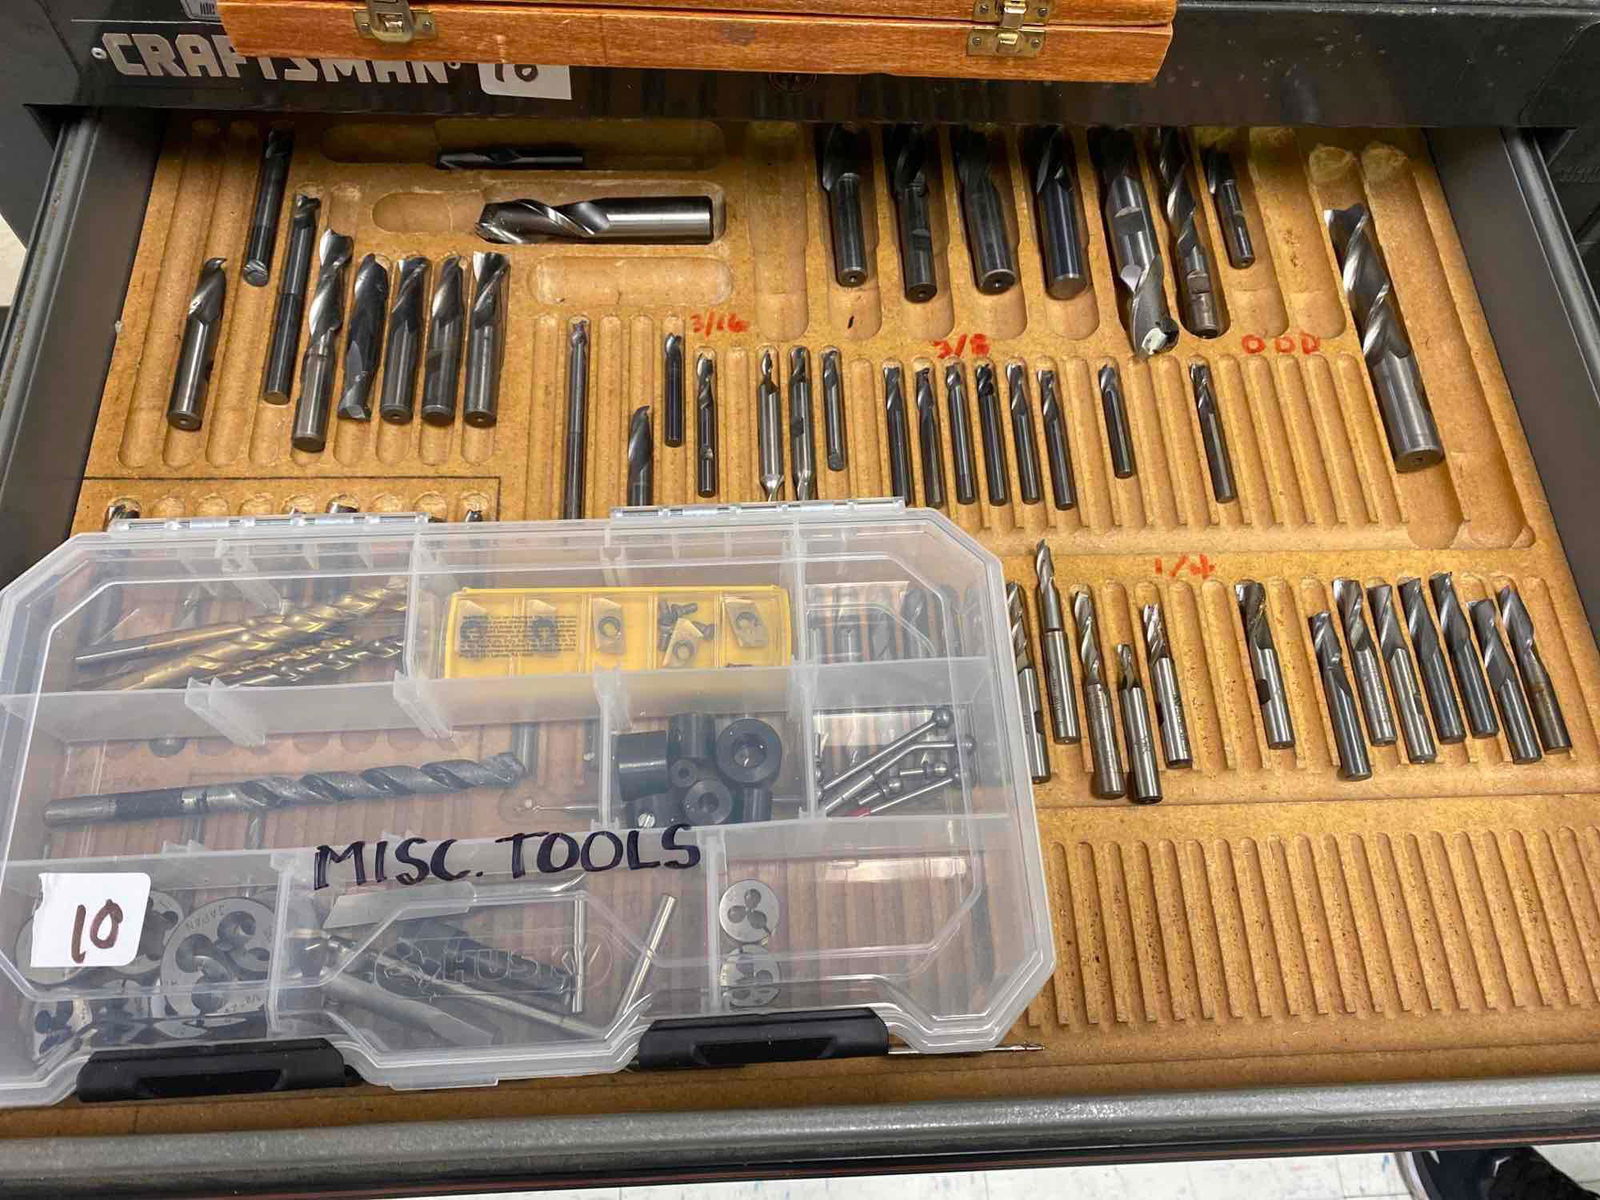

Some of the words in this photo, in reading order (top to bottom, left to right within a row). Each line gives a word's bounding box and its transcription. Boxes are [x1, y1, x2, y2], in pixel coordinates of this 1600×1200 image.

[931, 333, 990, 359] 3/8
[1154, 554, 1215, 579] 1/4
[314, 837, 483, 890] MISC.
[495, 823, 701, 879] TOOLS
[71, 899, 123, 964] 10
